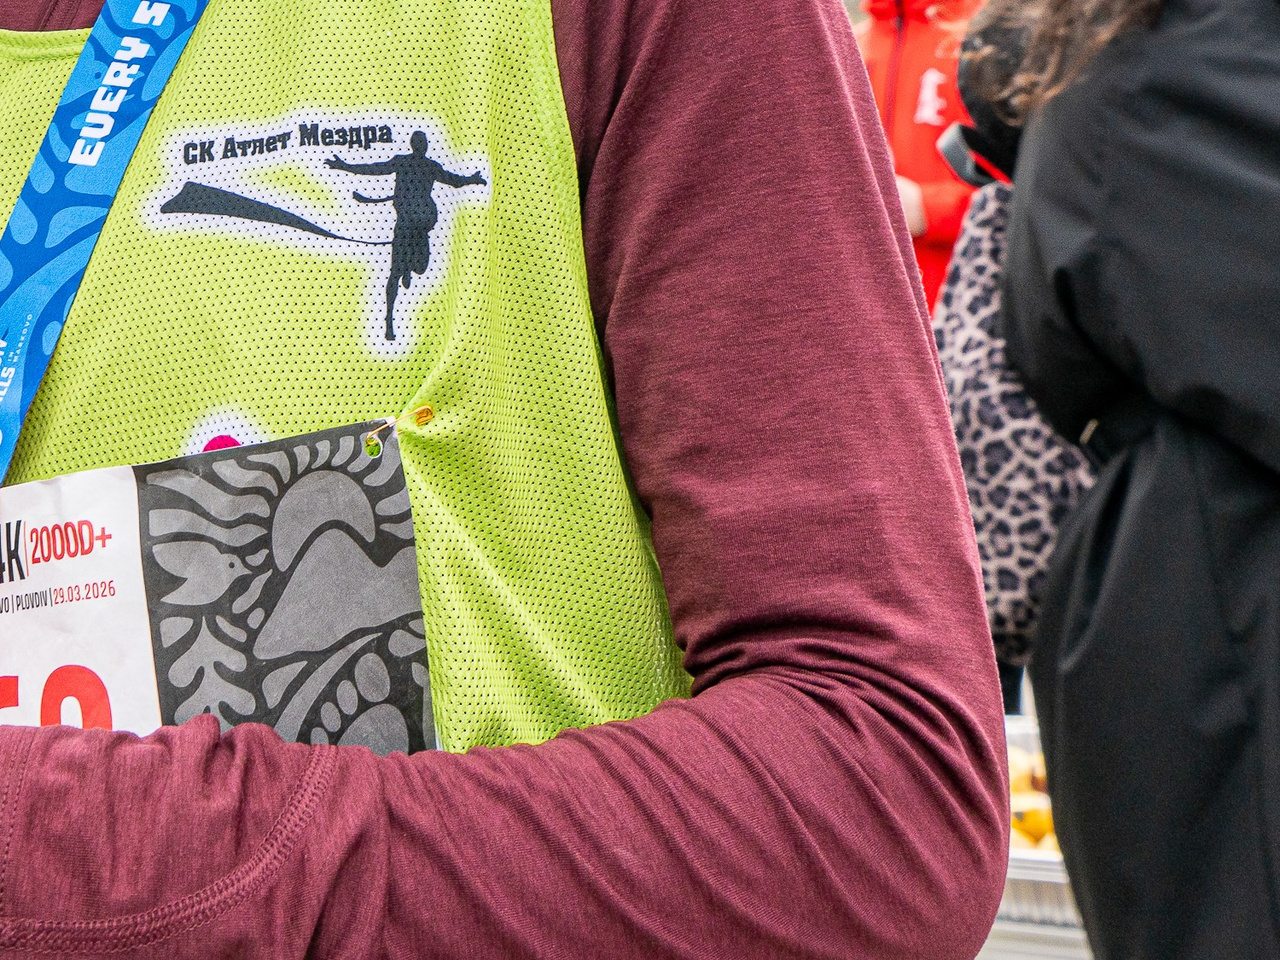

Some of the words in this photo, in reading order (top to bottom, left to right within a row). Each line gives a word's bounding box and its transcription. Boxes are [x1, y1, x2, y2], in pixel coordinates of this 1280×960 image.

[183, 140, 215, 165] СК
[221, 130, 293, 159] Атлет
[298, 123, 393, 149] Мездра
[30, 519, 112, 564] 2000D+
[16, 590, 48, 611] PLOVDIV
[53, 580, 116, 605] 29.03.2026
